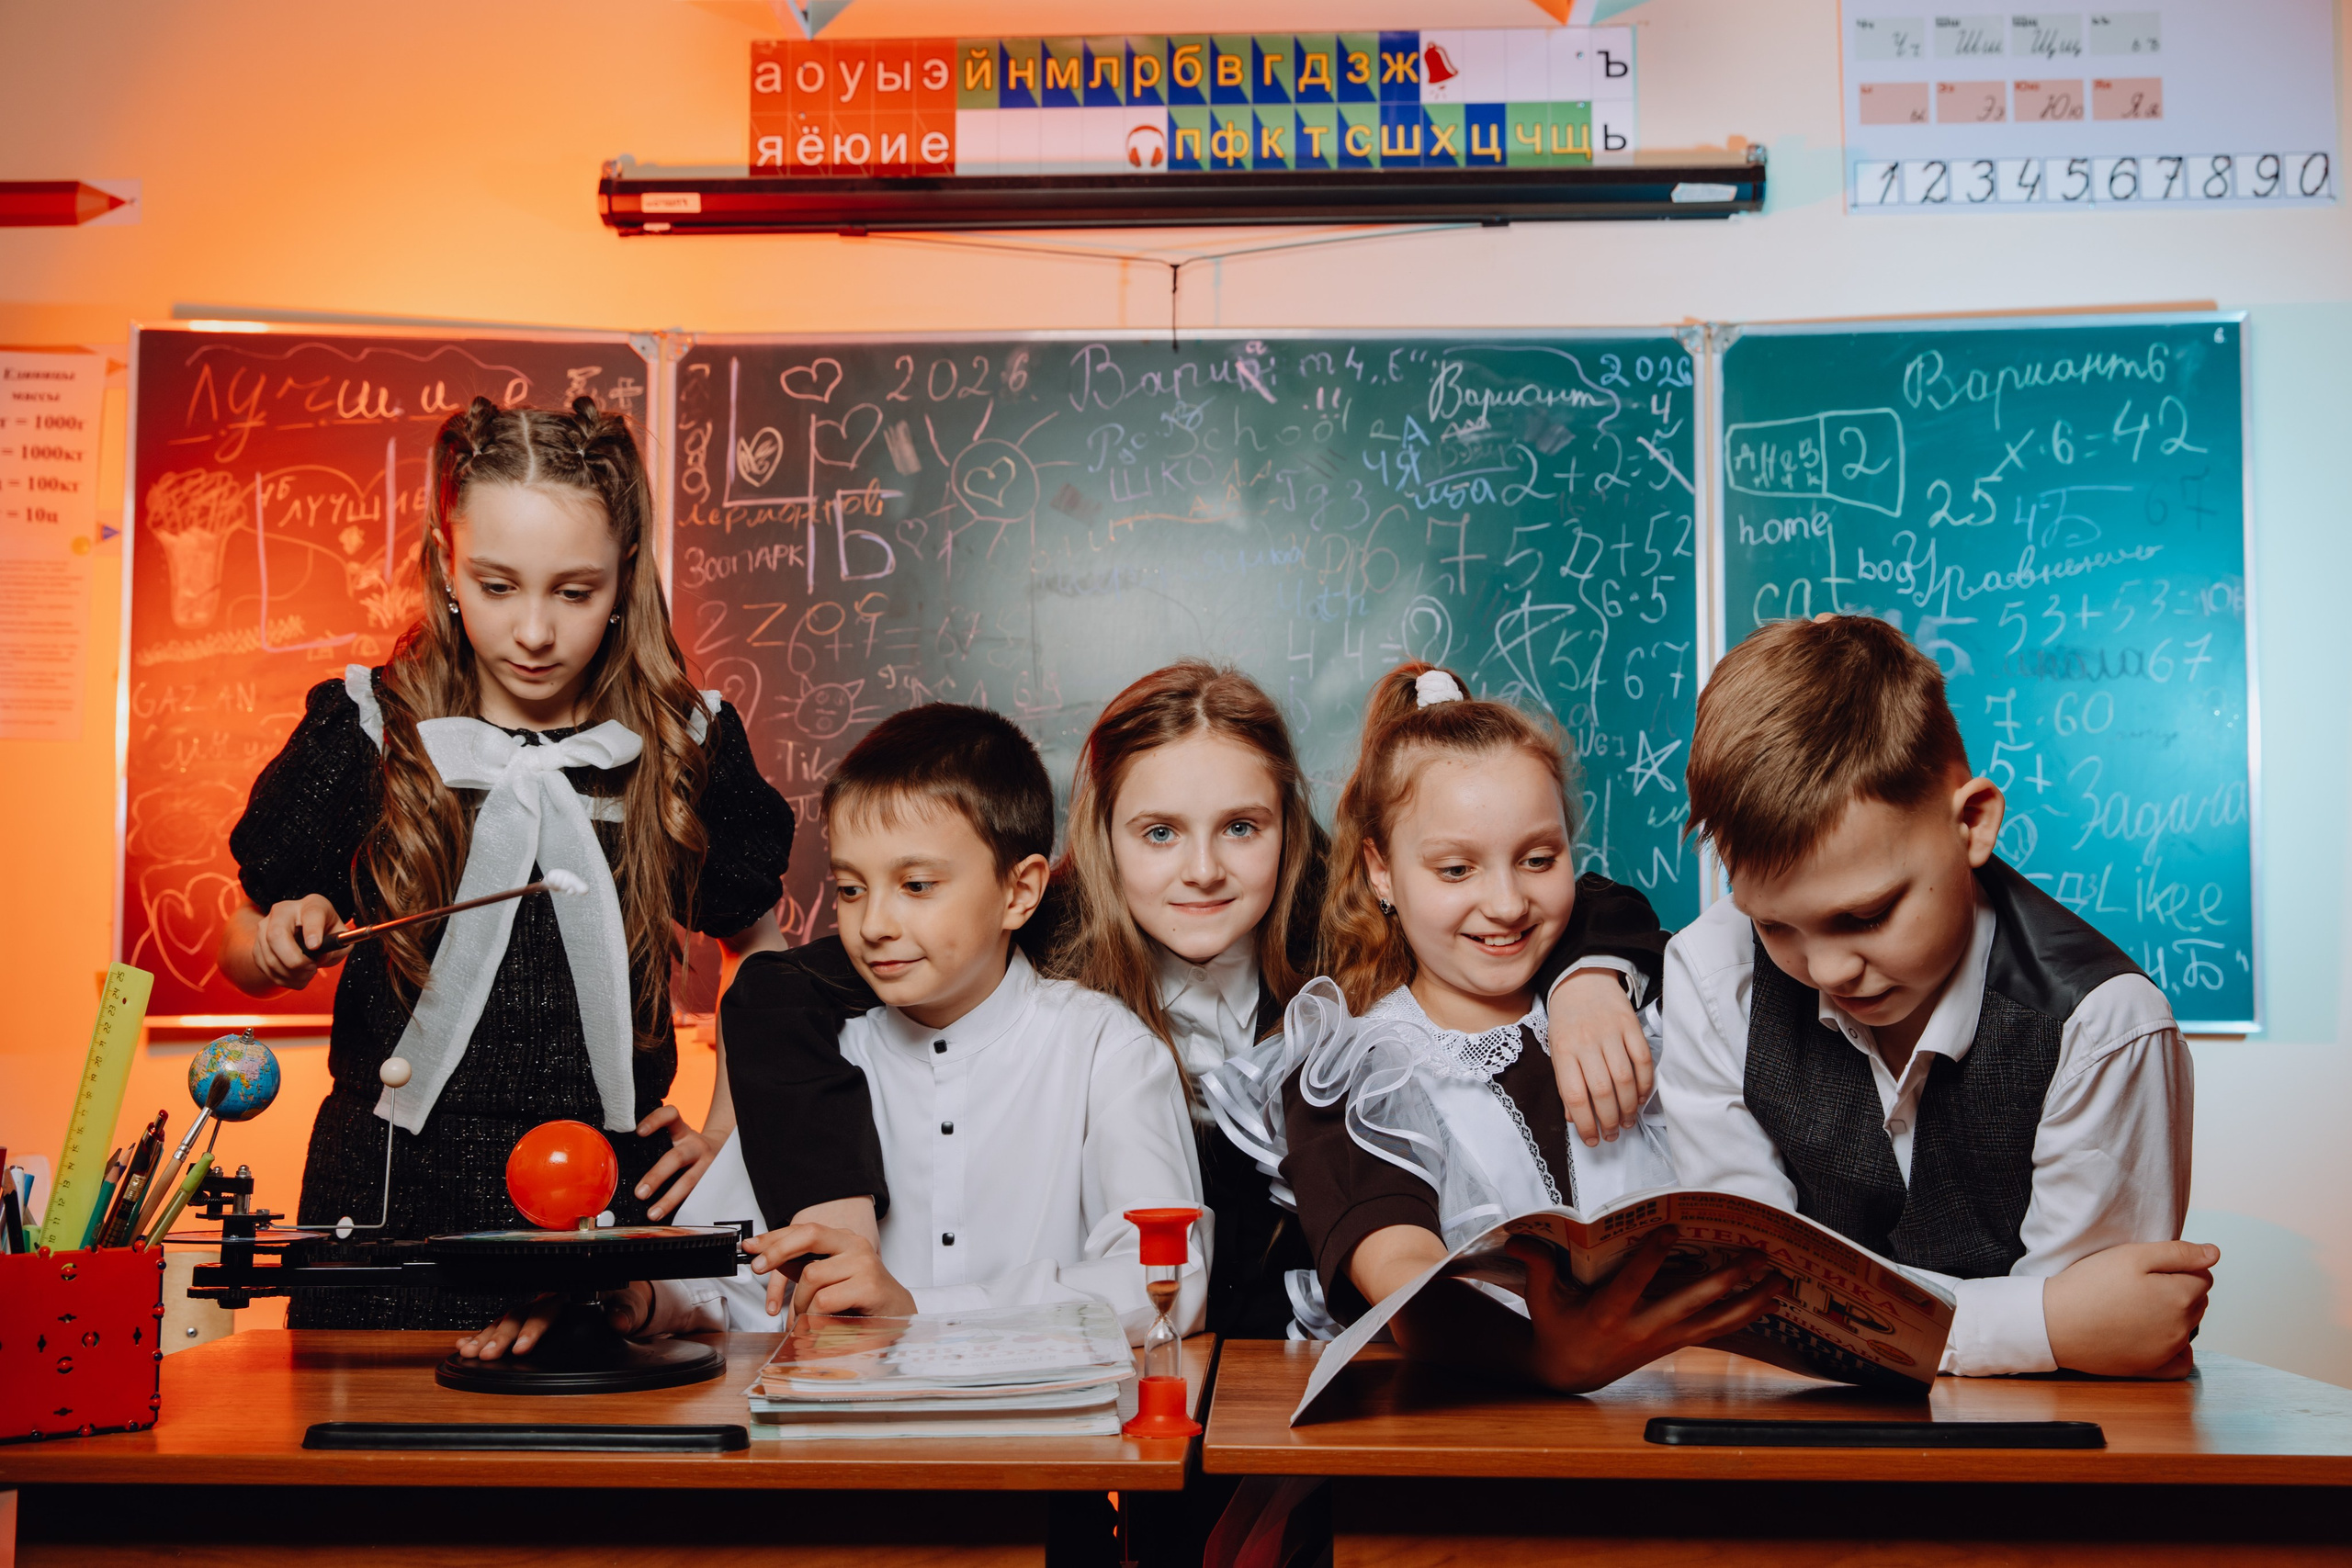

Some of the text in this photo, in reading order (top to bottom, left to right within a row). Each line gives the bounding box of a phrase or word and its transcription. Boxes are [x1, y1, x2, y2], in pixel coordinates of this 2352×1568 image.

[22, 445, 83, 460] 1000кг
[28, 477, 79, 491] 100кг
[117, 971, 125, 982] 25
[112, 987, 120, 999] 24
[107, 1004, 117, 1016] 23
[103, 1021, 112, 1033] 22
[95, 1056, 102, 1067] 20
[90, 1073, 97, 1082] 19
[72, 1144, 79, 1153] 15
[67, 1162, 75, 1170] 14
[62, 1179, 71, 1189] 13
[58, 1198, 66, 1207] 12
[52, 1217, 61, 1225] 11
[48, 1235, 57, 1244] 10
[1625, 1226, 1901, 1317] МТЕМАТИКА
